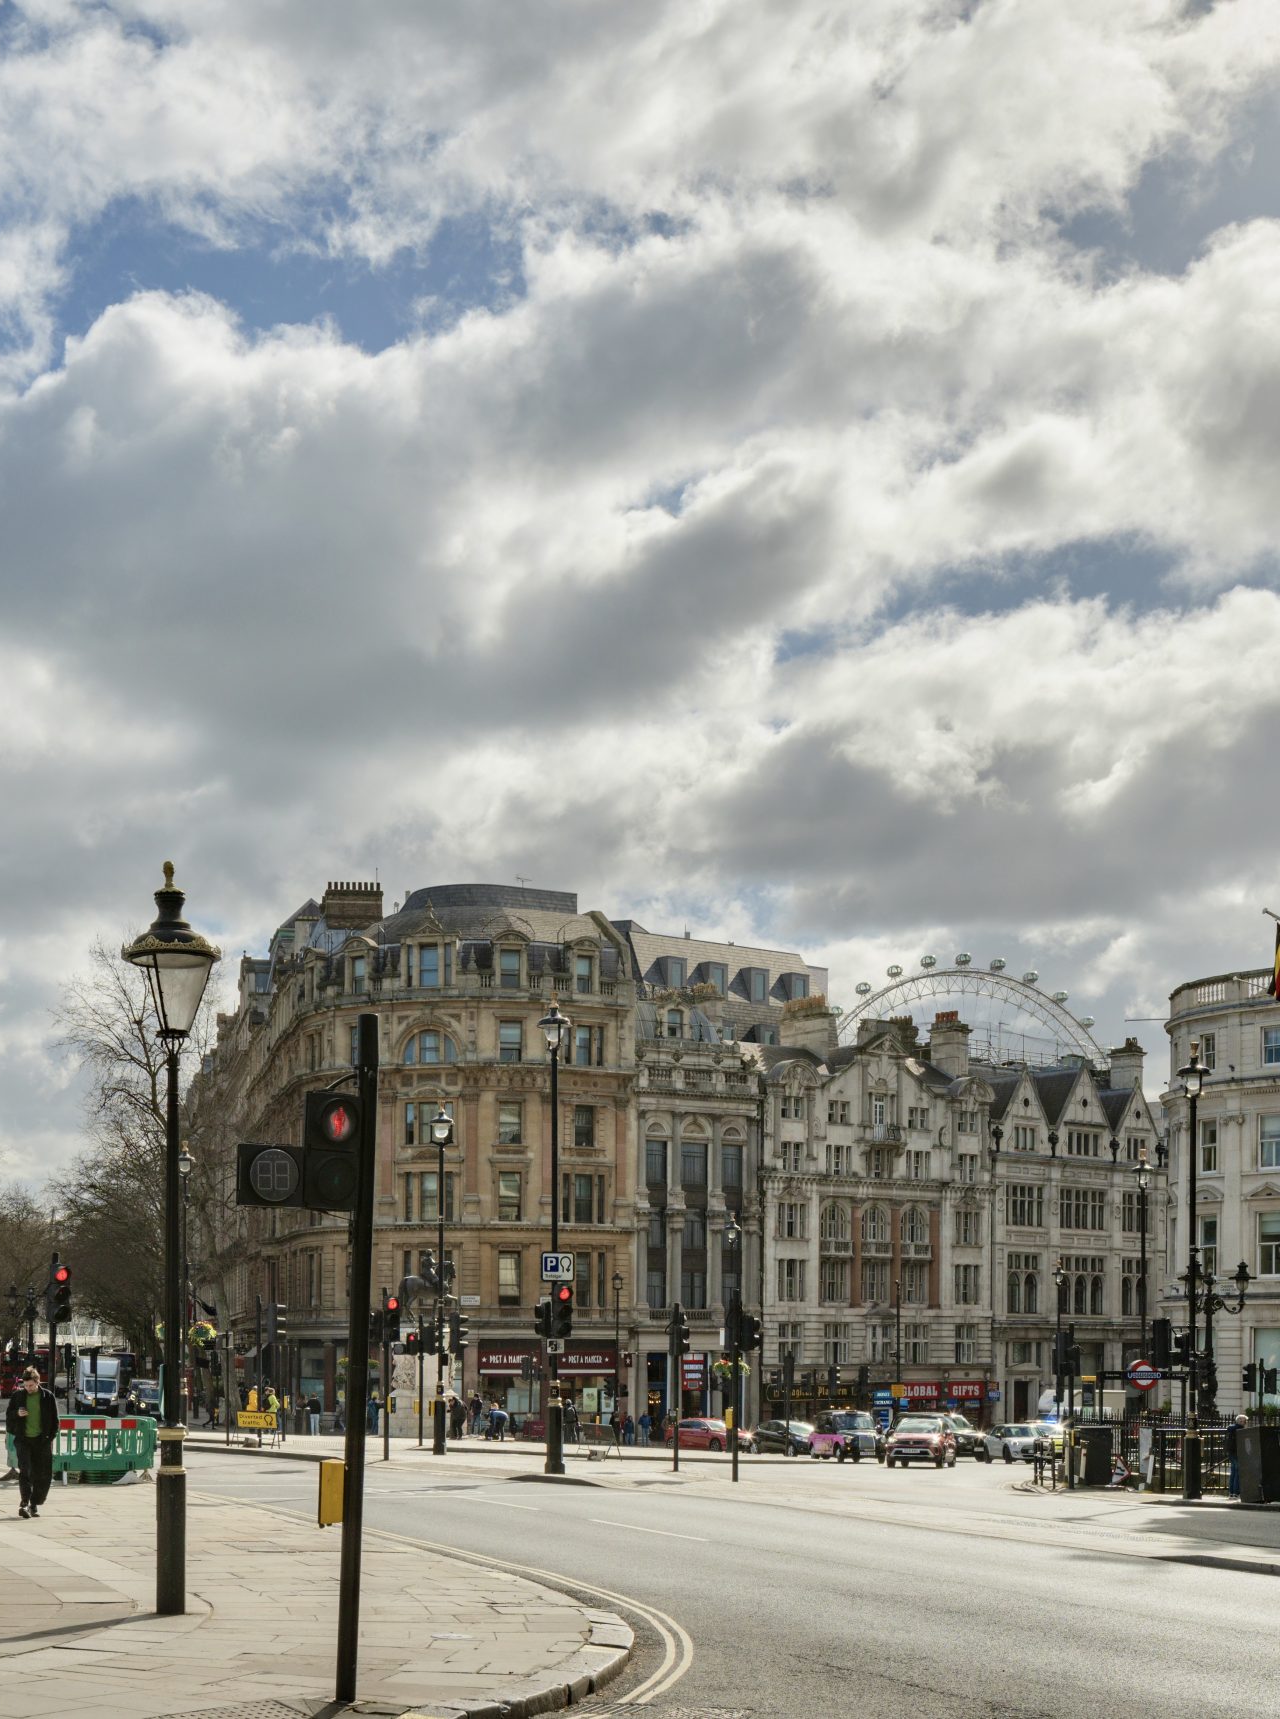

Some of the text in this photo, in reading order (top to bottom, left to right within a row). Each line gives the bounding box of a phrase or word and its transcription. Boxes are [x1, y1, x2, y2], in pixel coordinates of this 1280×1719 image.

[547, 1258, 556, 1270] P
[489, 1355, 502, 1364] PRET
[503, 1355, 507, 1364] A
[568, 1355, 579, 1364] PRET
[903, 1386, 938, 1396] GLOBAL
[952, 1386, 980, 1396] GIFTS
